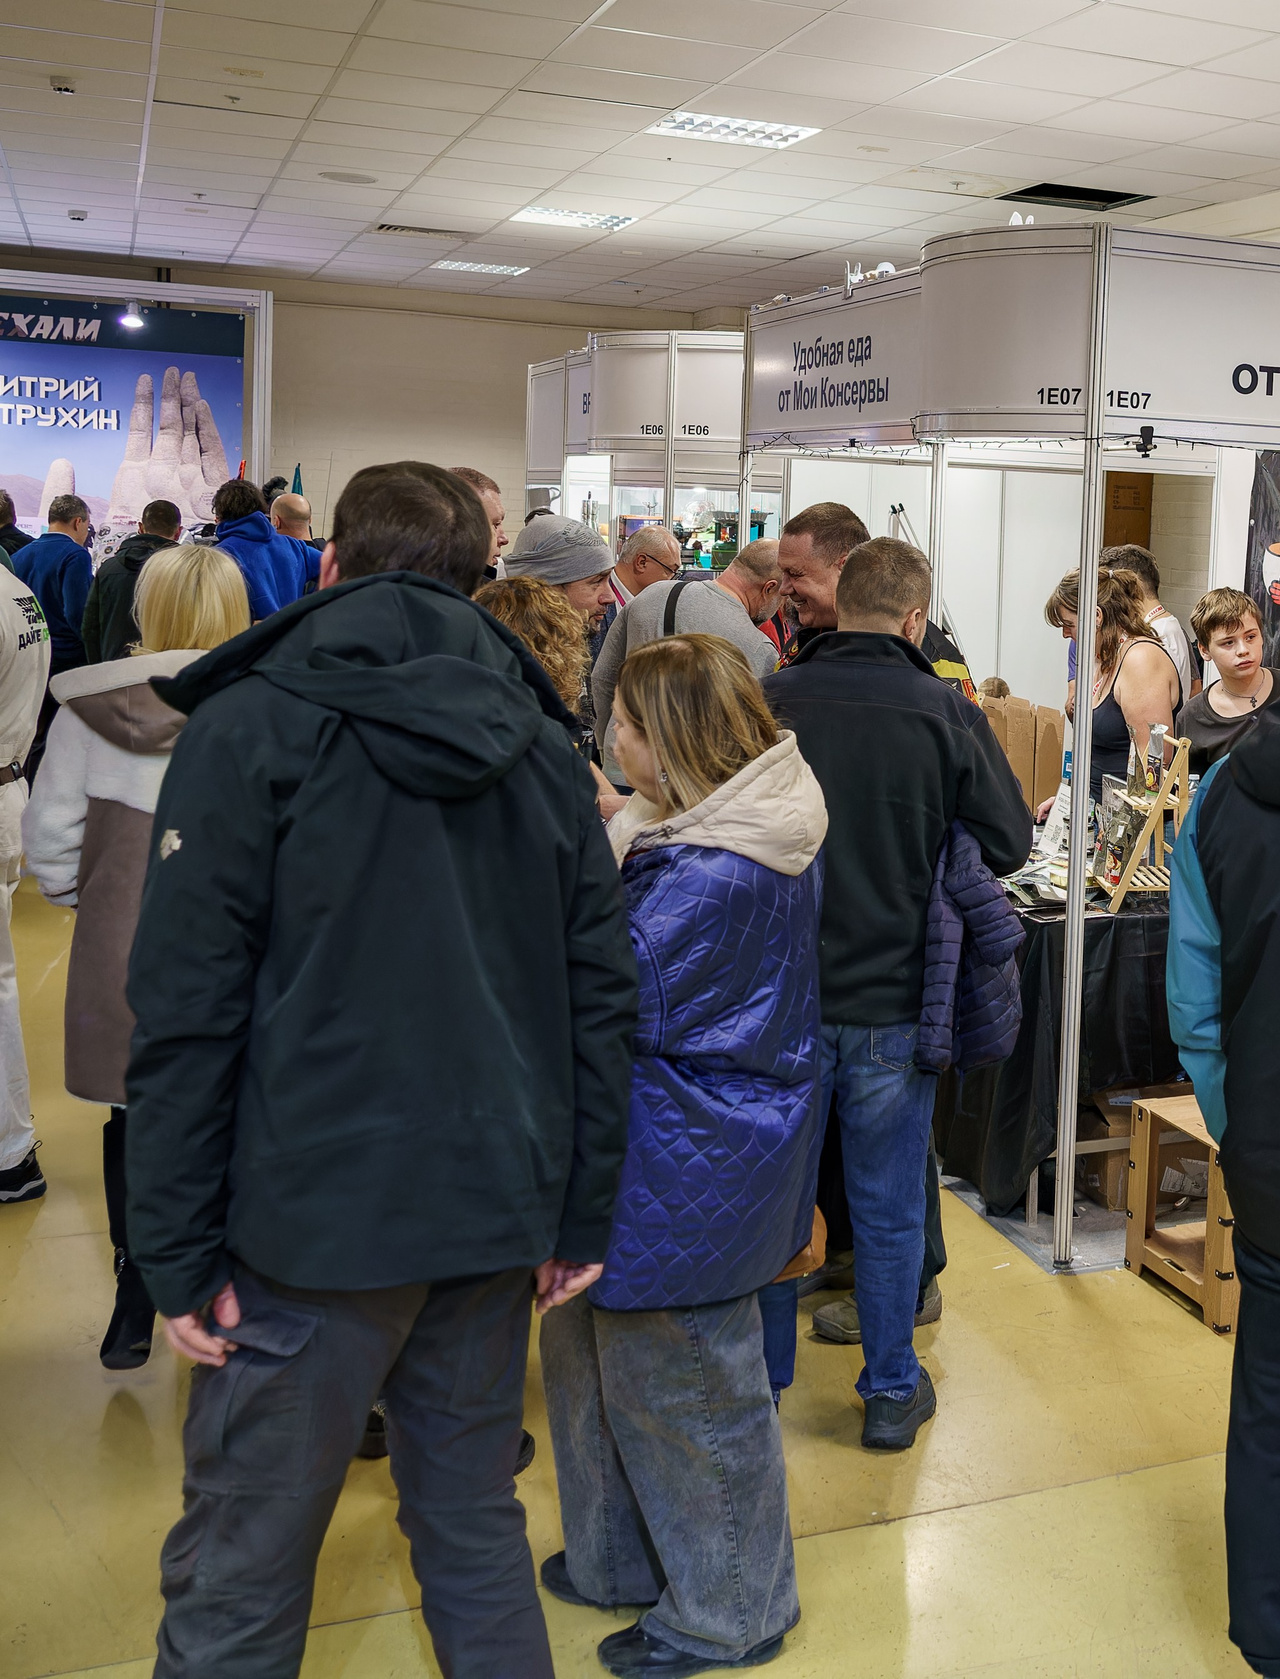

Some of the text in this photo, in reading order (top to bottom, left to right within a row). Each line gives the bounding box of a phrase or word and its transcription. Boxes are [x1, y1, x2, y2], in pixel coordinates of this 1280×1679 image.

[793, 335, 871, 376] Удобная еда
[0, 375, 100, 402] ИТРИЙ
[778, 376, 889, 413] от Мои Консервы
[1037, 387, 1082, 406] 1E07
[1106, 389, 1152, 410] 1E07
[0, 403, 118, 431] ТРУХИН
[640, 424, 664, 435] 1E06
[681, 424, 710, 436] 1E06
